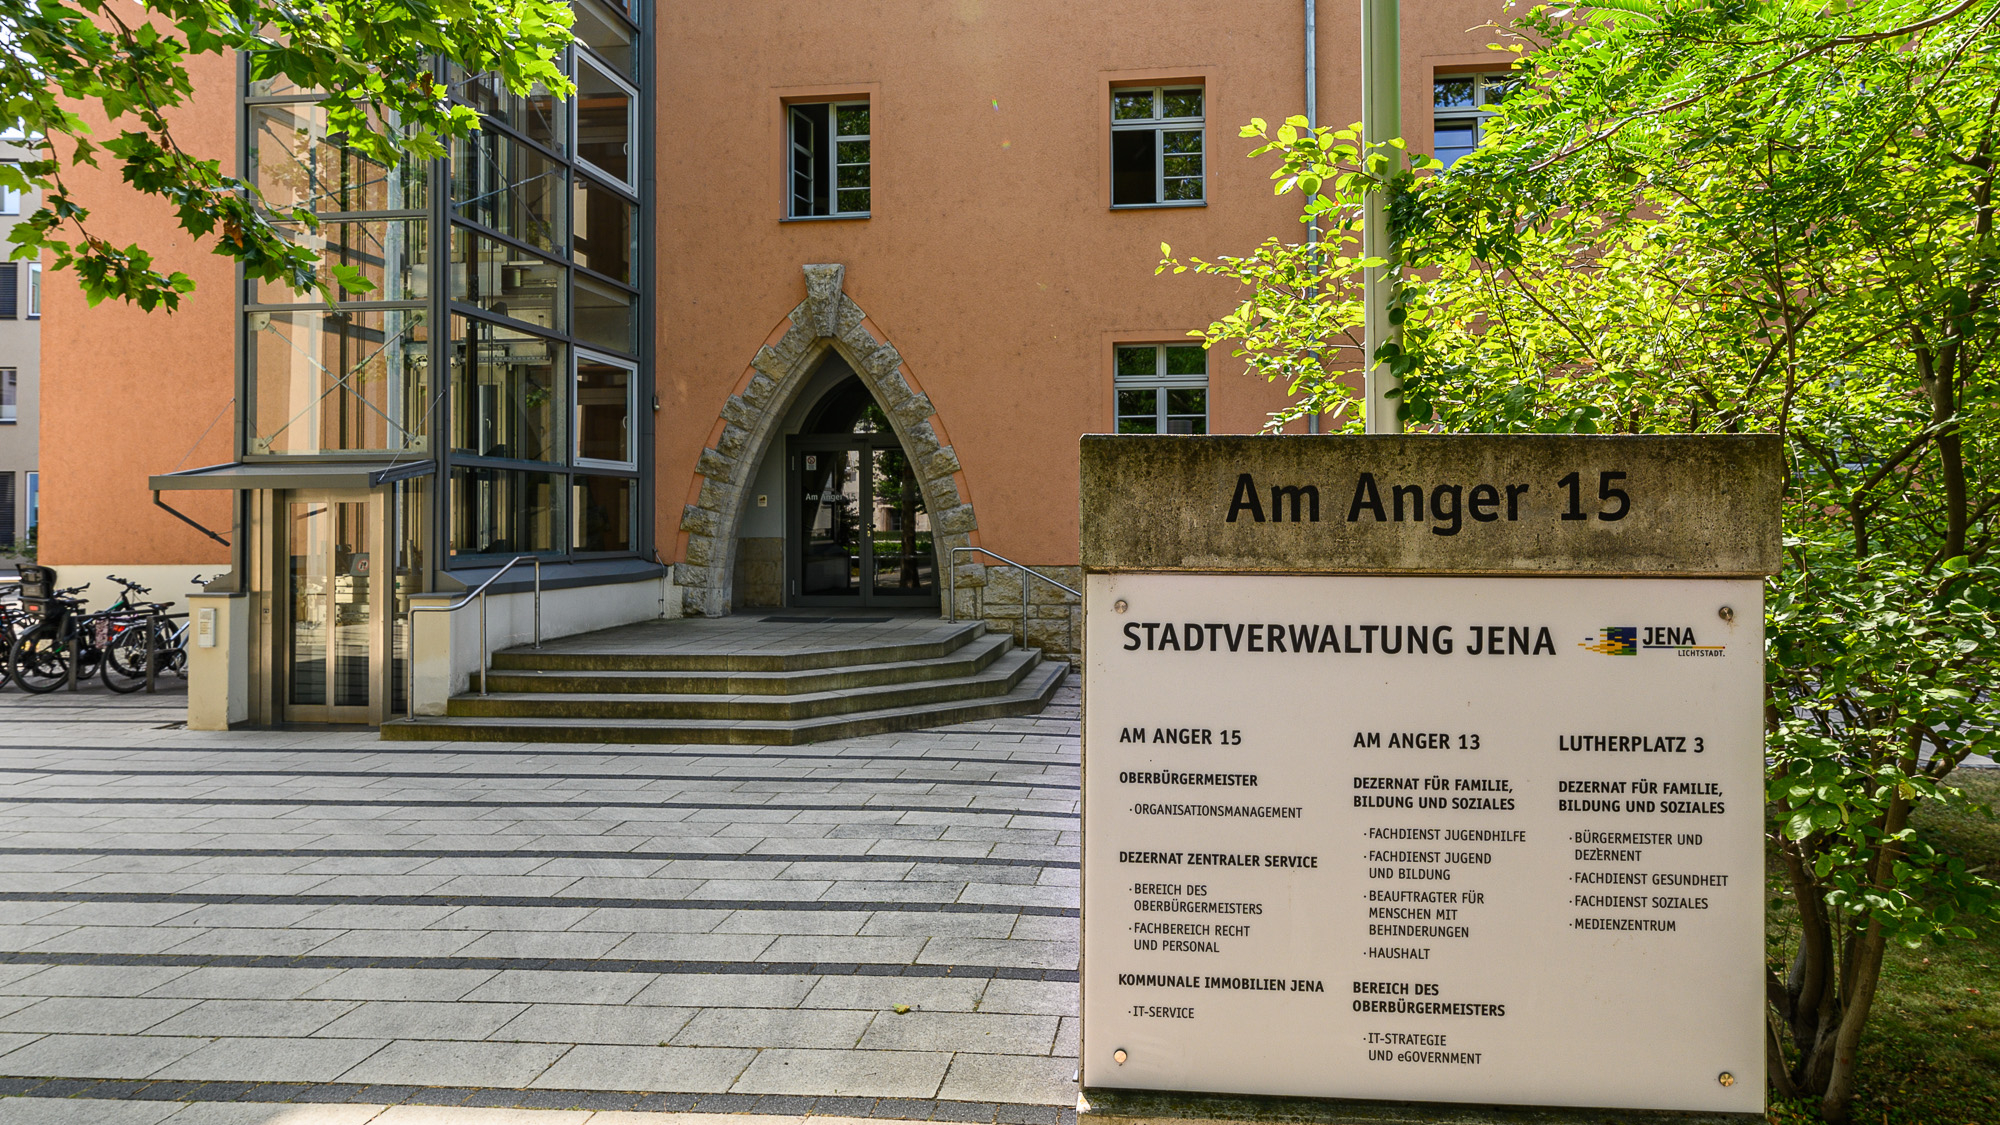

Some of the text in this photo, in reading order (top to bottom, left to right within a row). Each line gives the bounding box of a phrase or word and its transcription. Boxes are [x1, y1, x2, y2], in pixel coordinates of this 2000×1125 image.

[805, 493, 818, 501] Am
[1227, 471, 1631, 536] Am Anger 15
[1123, 622, 1556, 655] STADTVERWALTUNG JENA
[1642, 627, 1696, 645] JENA
[1678, 648, 1725, 657] LICHTSTADT.
[1119, 727, 1241, 745] AM ANGER 15
[1353, 732, 1480, 750] AM ANGER 13
[1559, 735, 1704, 753] LUTHERPLATZ 3
[1119, 769, 1258, 786] OBERBÜRGERMEISTER
[1354, 775, 1513, 793] DEZERNAT FÜR FAMILIE,
[1559, 779, 1722, 797] DEZERNAT FÜR FAMILIE,
[1354, 796, 1515, 810] BILDUNG UND SOZIALES
[1559, 799, 1725, 814] BILDUNG UND SOZIALES
[1135, 803, 1302, 818] ORGANISATIONSMANAGEMENT
[1370, 828, 1526, 842] FACHDIENST JUGENDHILFE
[1575, 829, 1702, 845] BÜRGERMEISTER UND
[1120, 851, 1318, 868] DEZERNAT ZENTRALER SERVICE
[1370, 850, 1491, 864] FACHDIENST JUGEND
[1575, 848, 1642, 861] DEZERNENT
[1369, 868, 1450, 880] UND BILDUNG
[1575, 872, 1728, 886] FACHDIENST GESUNDHEIT
[1135, 883, 1207, 896] BEREICH DES
[1370, 890, 1484, 904] BEAUFTRAGTER FÜR
[1575, 895, 1708, 909] FACHDIENST SOZIALES
[1134, 898, 1262, 915] OBERBÜRGERMEISTERS
[1369, 907, 1458, 920] MENSCHEN MIT
[1135, 922, 1250, 936] FACHBEREICH RECHT
[1369, 924, 1469, 938] BEHINDERUNGEN
[1575, 918, 1676, 931] MEDIENZENTRUM
[1134, 939, 1220, 953] UND PERSONAL
[1369, 947, 1430, 959] HAUSHALT
[1119, 974, 1324, 992] KOMMUNALE IMMOBILIEN JENA
[1353, 981, 1439, 996] BEREICH DES
[1133, 1006, 1194, 1019] IT-SERVICE
[1353, 998, 1505, 1016] OBERBÜRGERMEISTERS
[1368, 1033, 1446, 1046] IT-STRATEGIE
[1369, 1050, 1482, 1064] UND eGOVERNMENT
